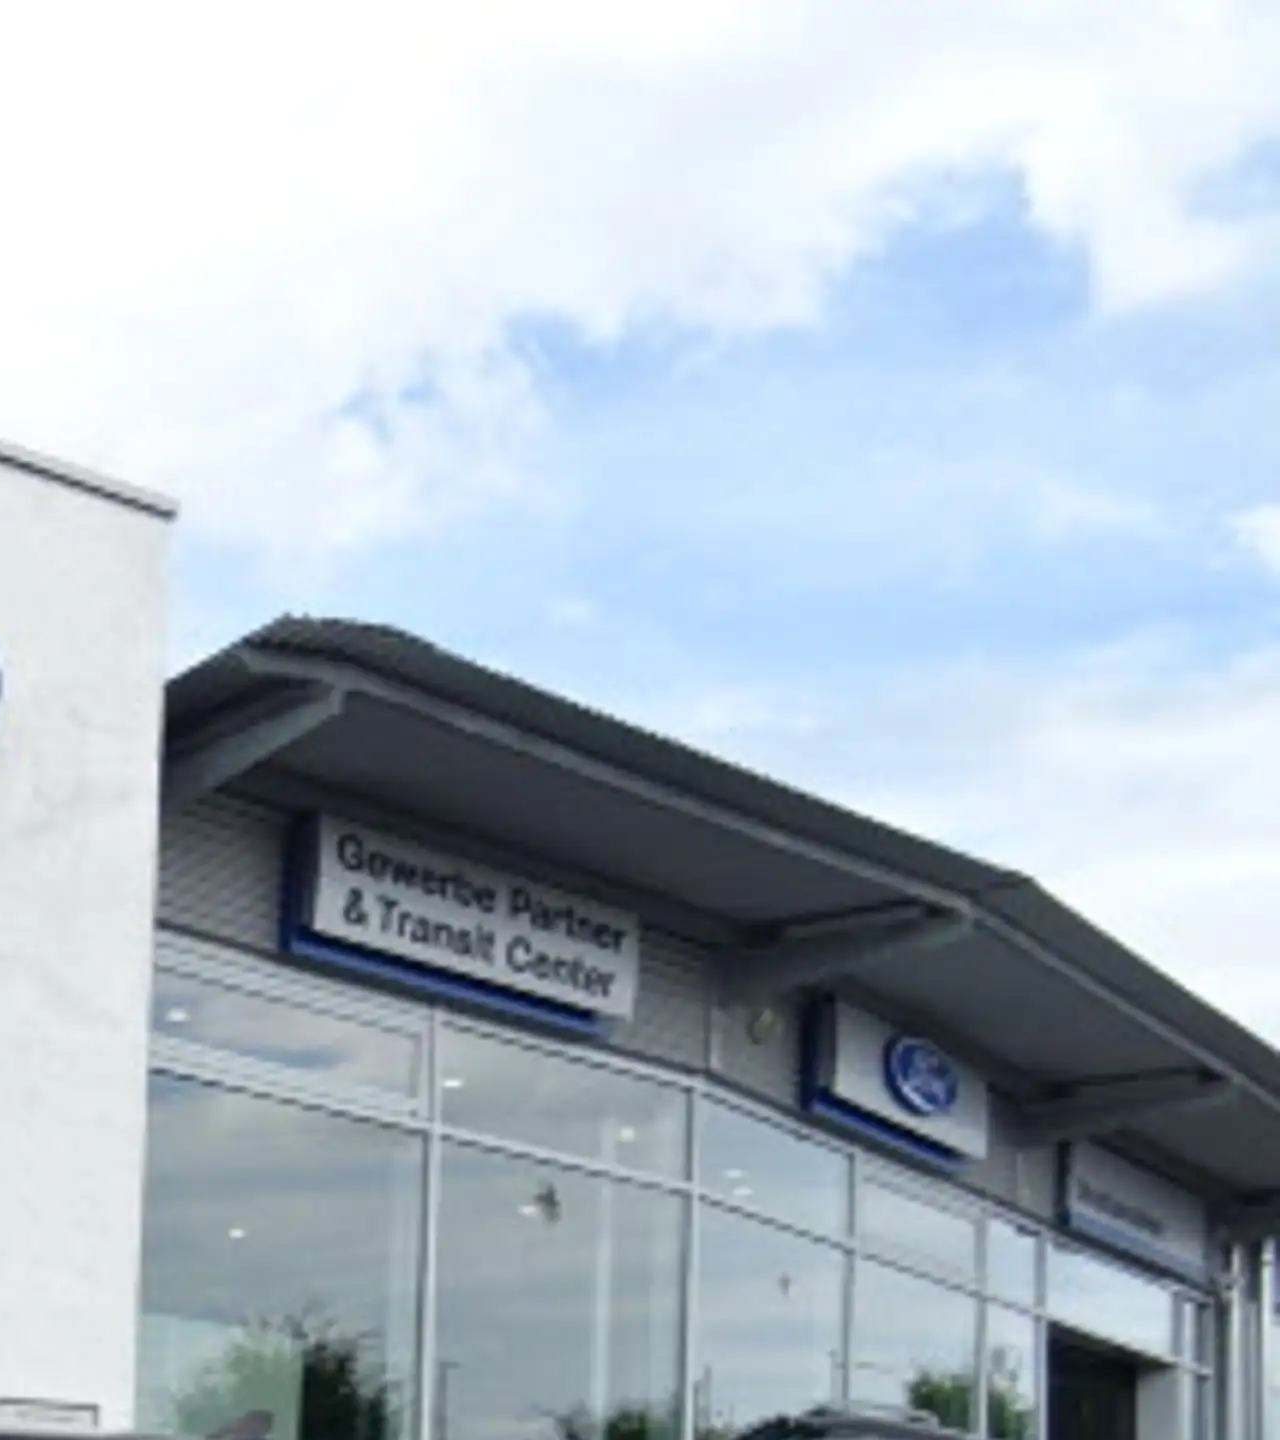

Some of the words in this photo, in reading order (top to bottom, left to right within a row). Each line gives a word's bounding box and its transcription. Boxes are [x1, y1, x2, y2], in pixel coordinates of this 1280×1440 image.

[344, 886, 370, 926] &
[377, 895, 496, 968] Transit
[506, 935, 617, 998] Center
[507, 885, 628, 953] Partner
